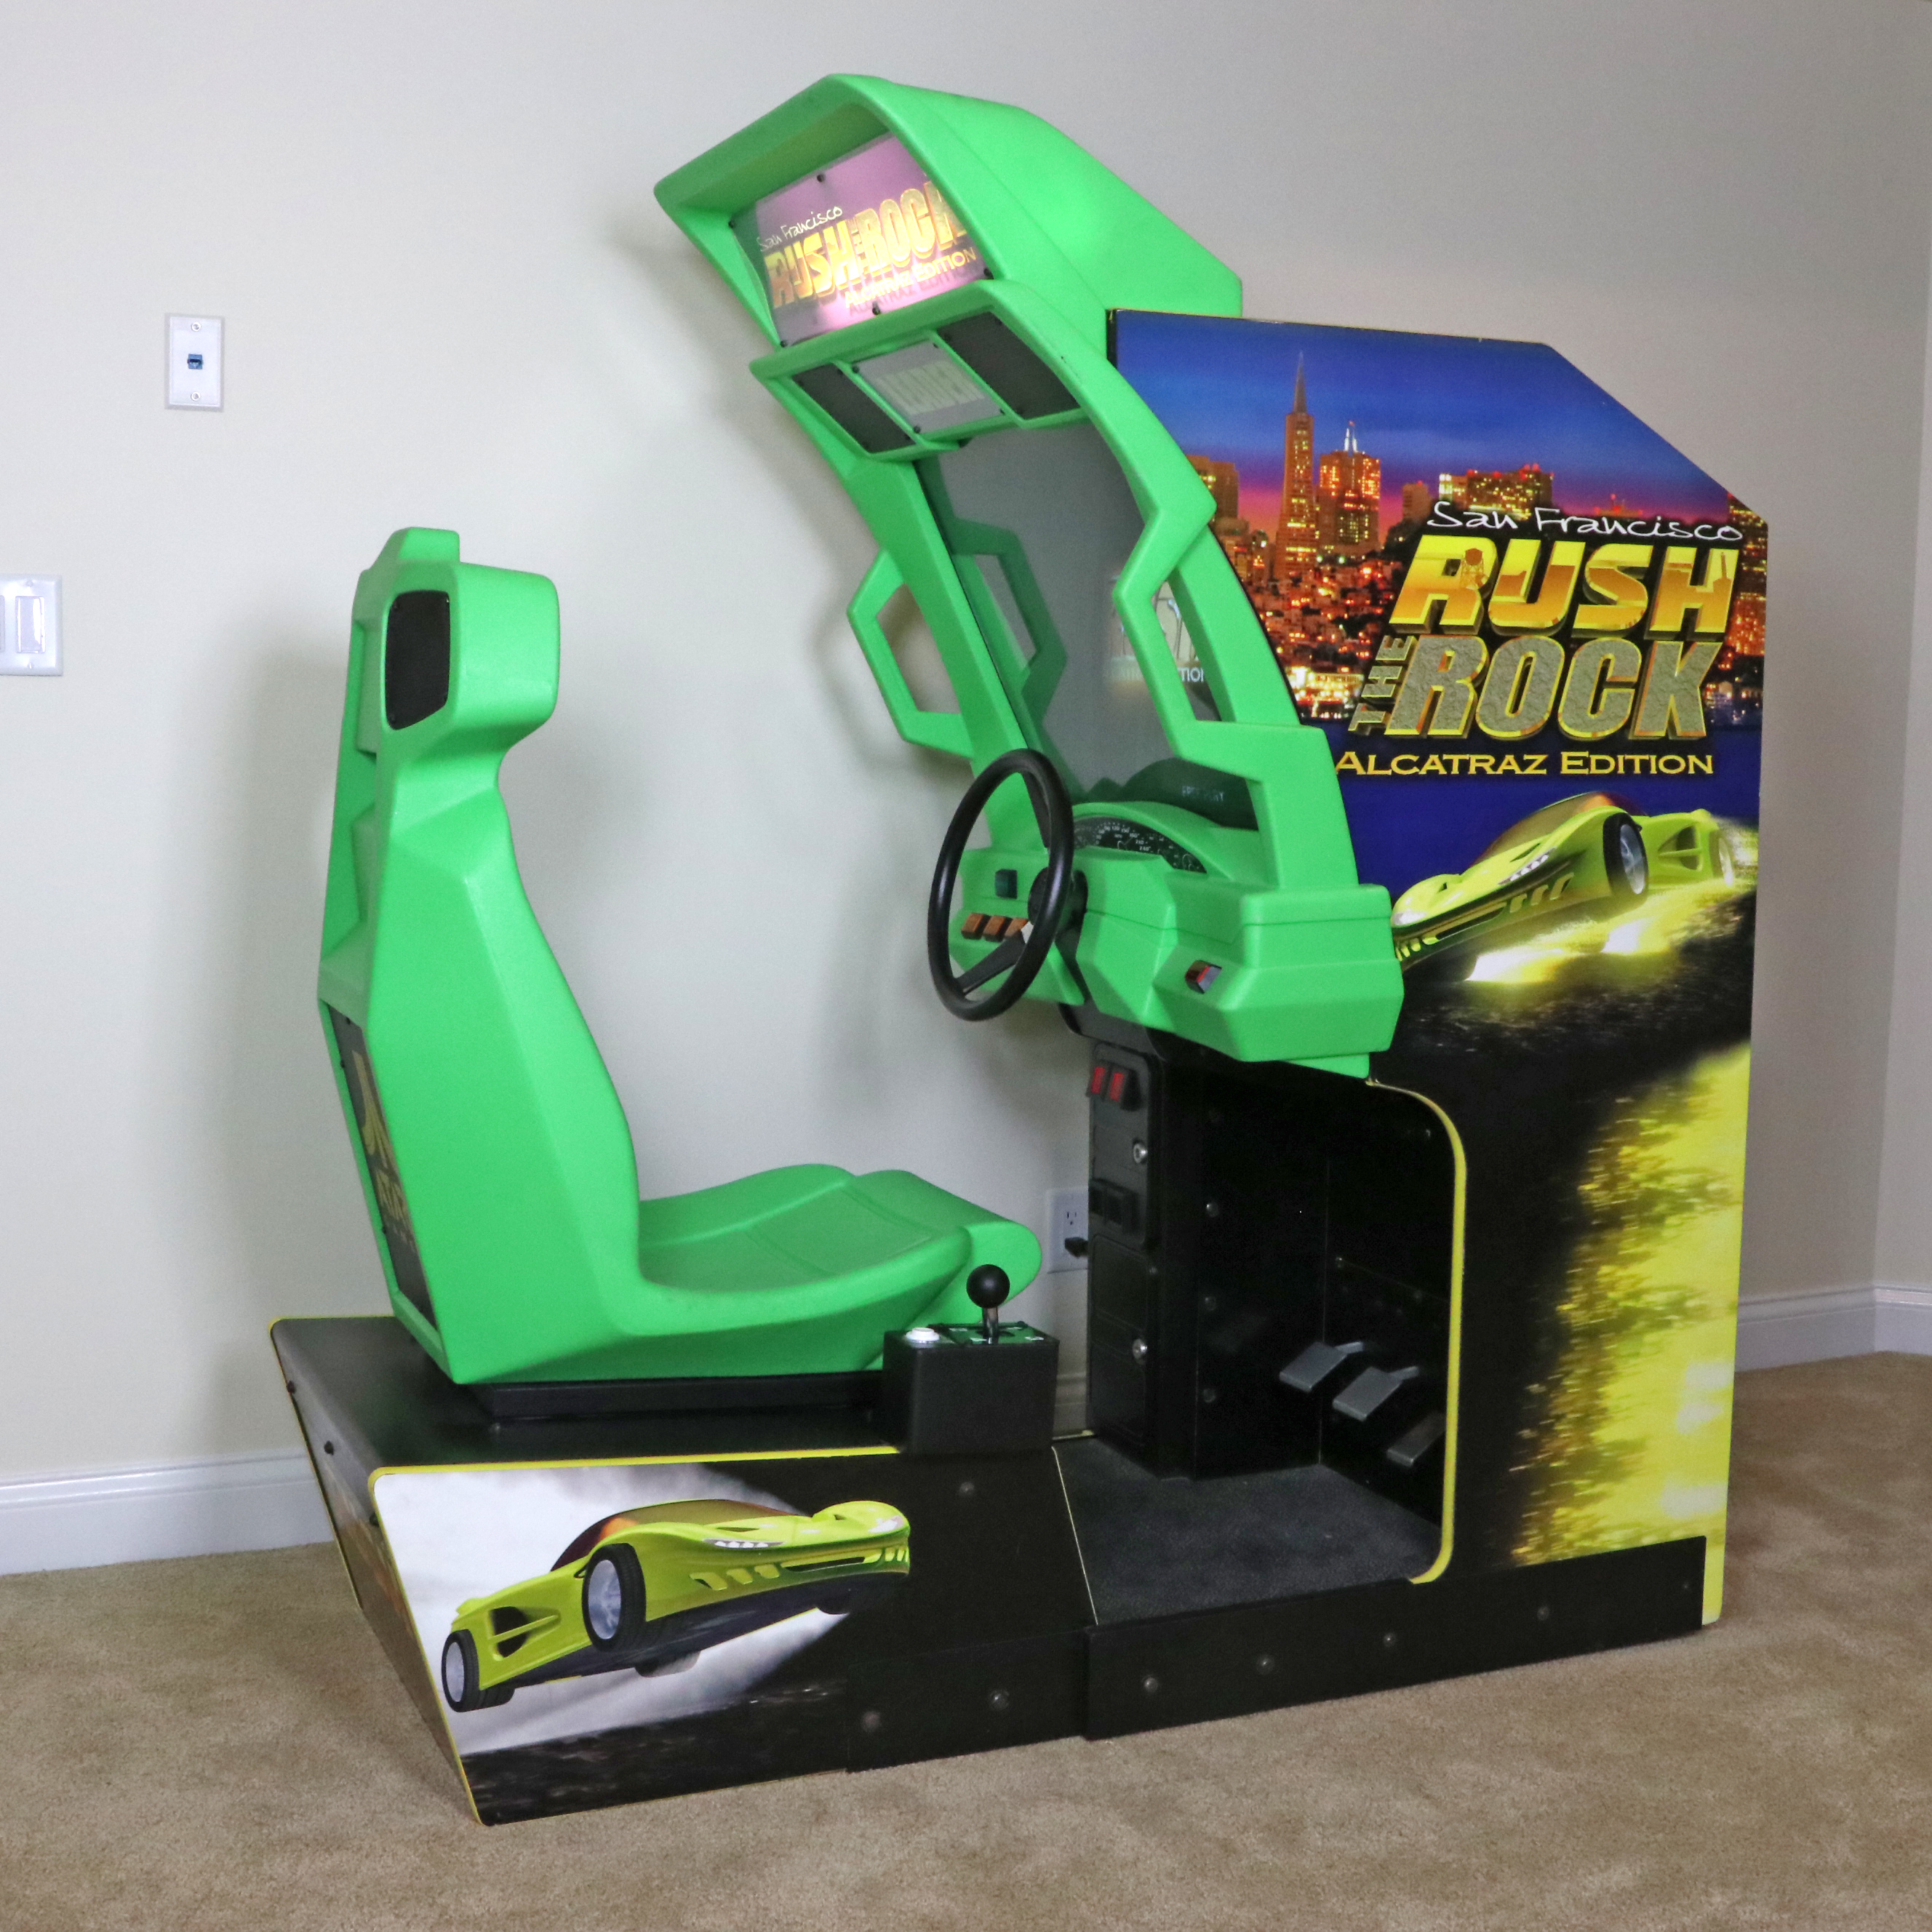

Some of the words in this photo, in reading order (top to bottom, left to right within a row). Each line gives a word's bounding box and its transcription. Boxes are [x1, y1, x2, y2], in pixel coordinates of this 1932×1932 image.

[756, 234, 783, 252] San
[780, 206, 843, 237] Francisco
[764, 220, 861, 308] RUSH
[844, 271, 911, 308] ALCATRAZ
[912, 247, 977, 284] EDITION
[1426, 500, 1519, 530] San
[1536, 507, 1744, 541] Francisco
[1389, 534, 1739, 640] RUSH
[1348, 634, 1418, 735] THE
[1384, 634, 1723, 741] ROCK
[1336, 751, 1548, 775] ALCATRAZ
[1560, 751, 1714, 775] EDITION
